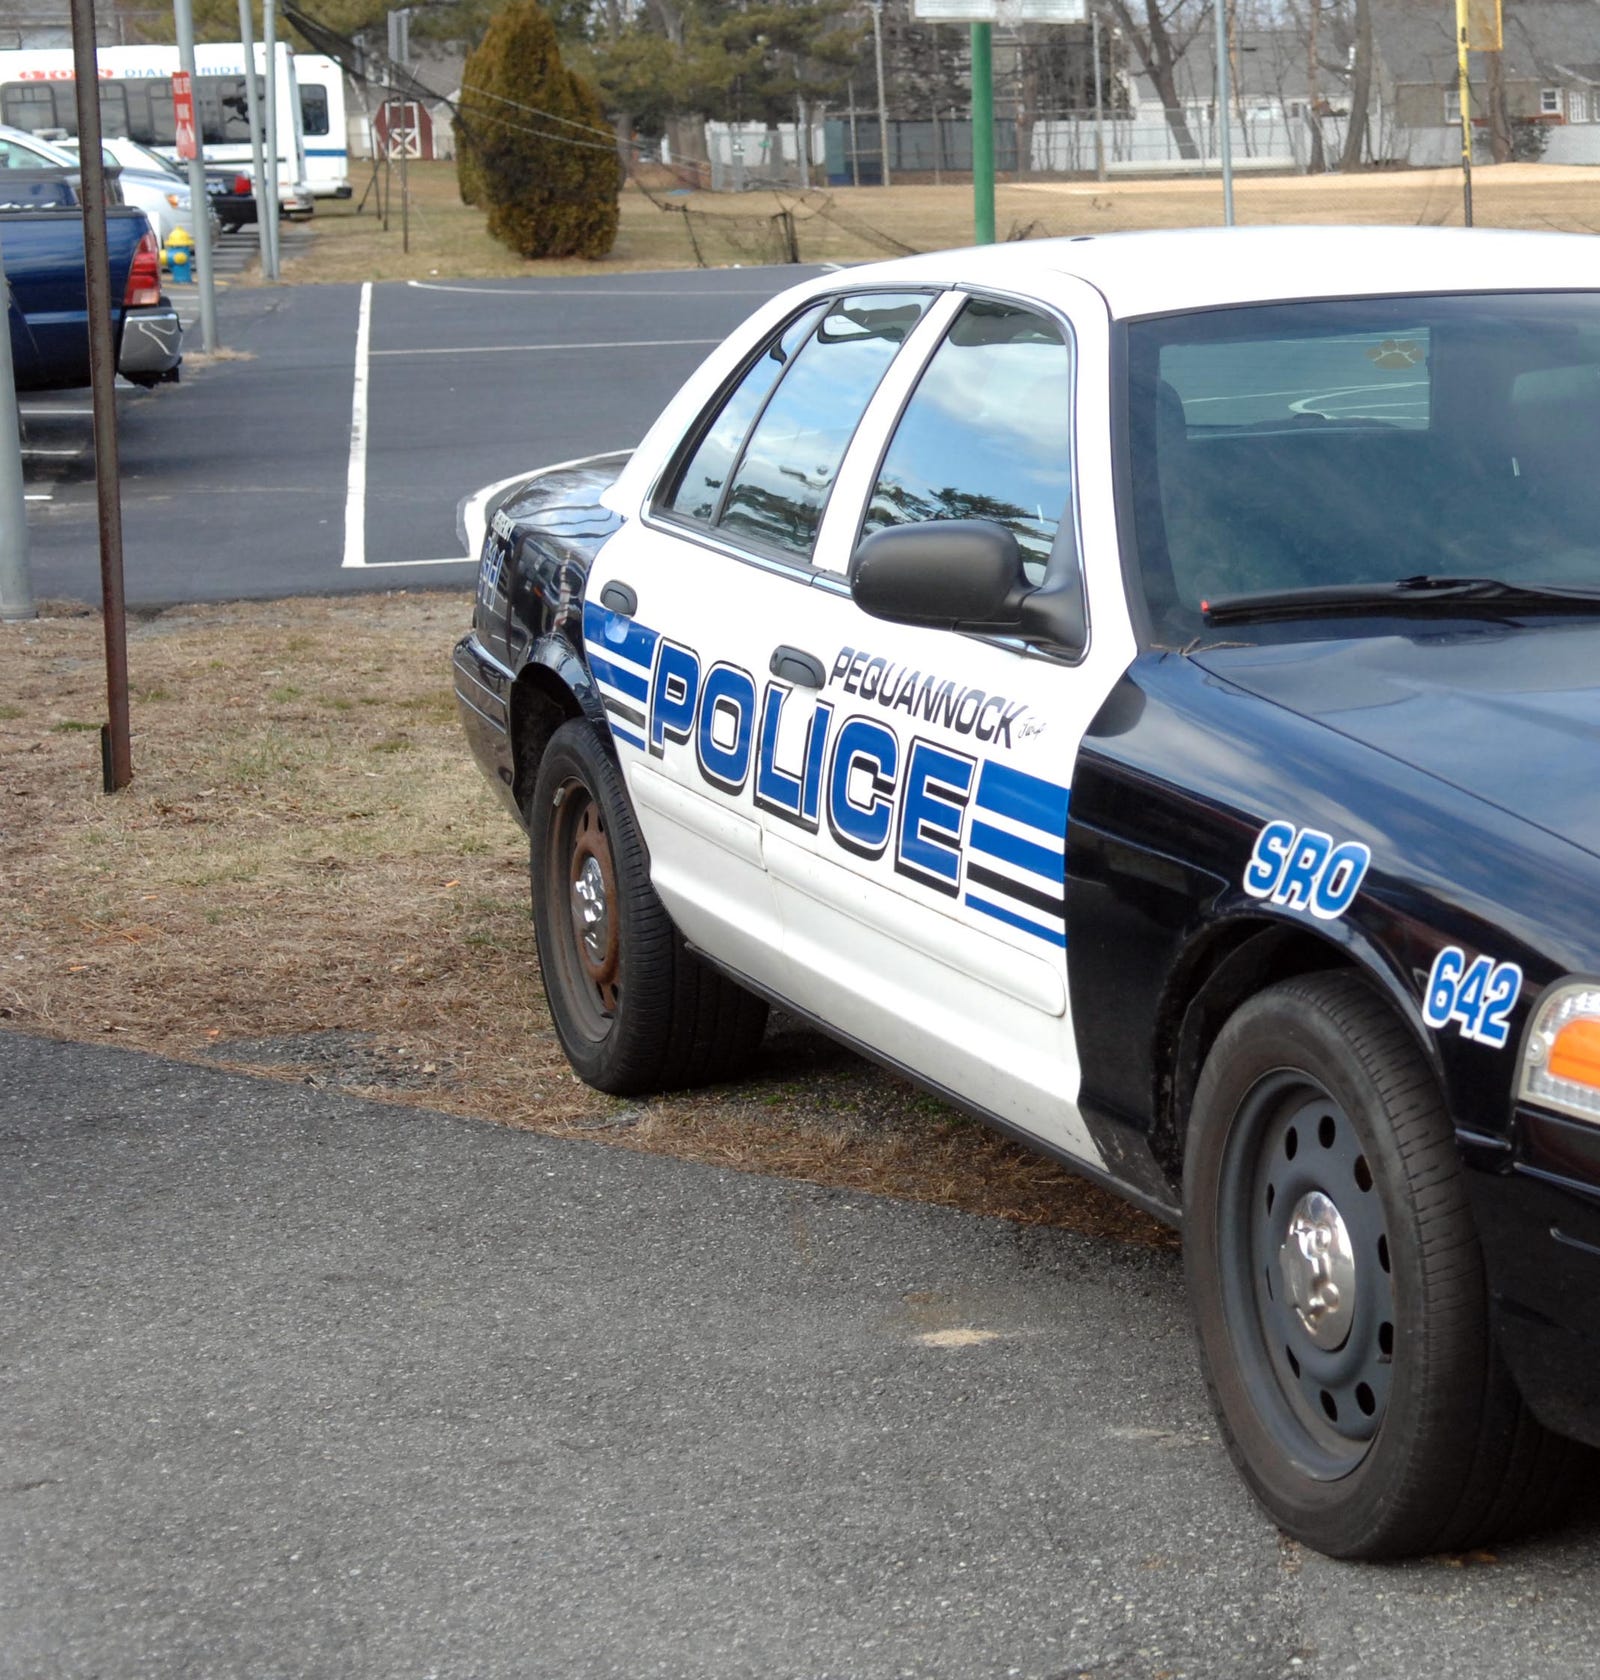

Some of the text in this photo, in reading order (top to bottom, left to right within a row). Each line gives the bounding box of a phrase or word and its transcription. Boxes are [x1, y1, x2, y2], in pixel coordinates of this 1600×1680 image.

[124, 68, 163, 78] DIAL
[201, 66, 241, 76] RIDE
[829, 646, 1029, 749] PEQUANNOCK
[649, 636, 976, 898] POLICE
[1243, 819, 1371, 920] SRO
[1422, 946, 1523, 1048] 642
